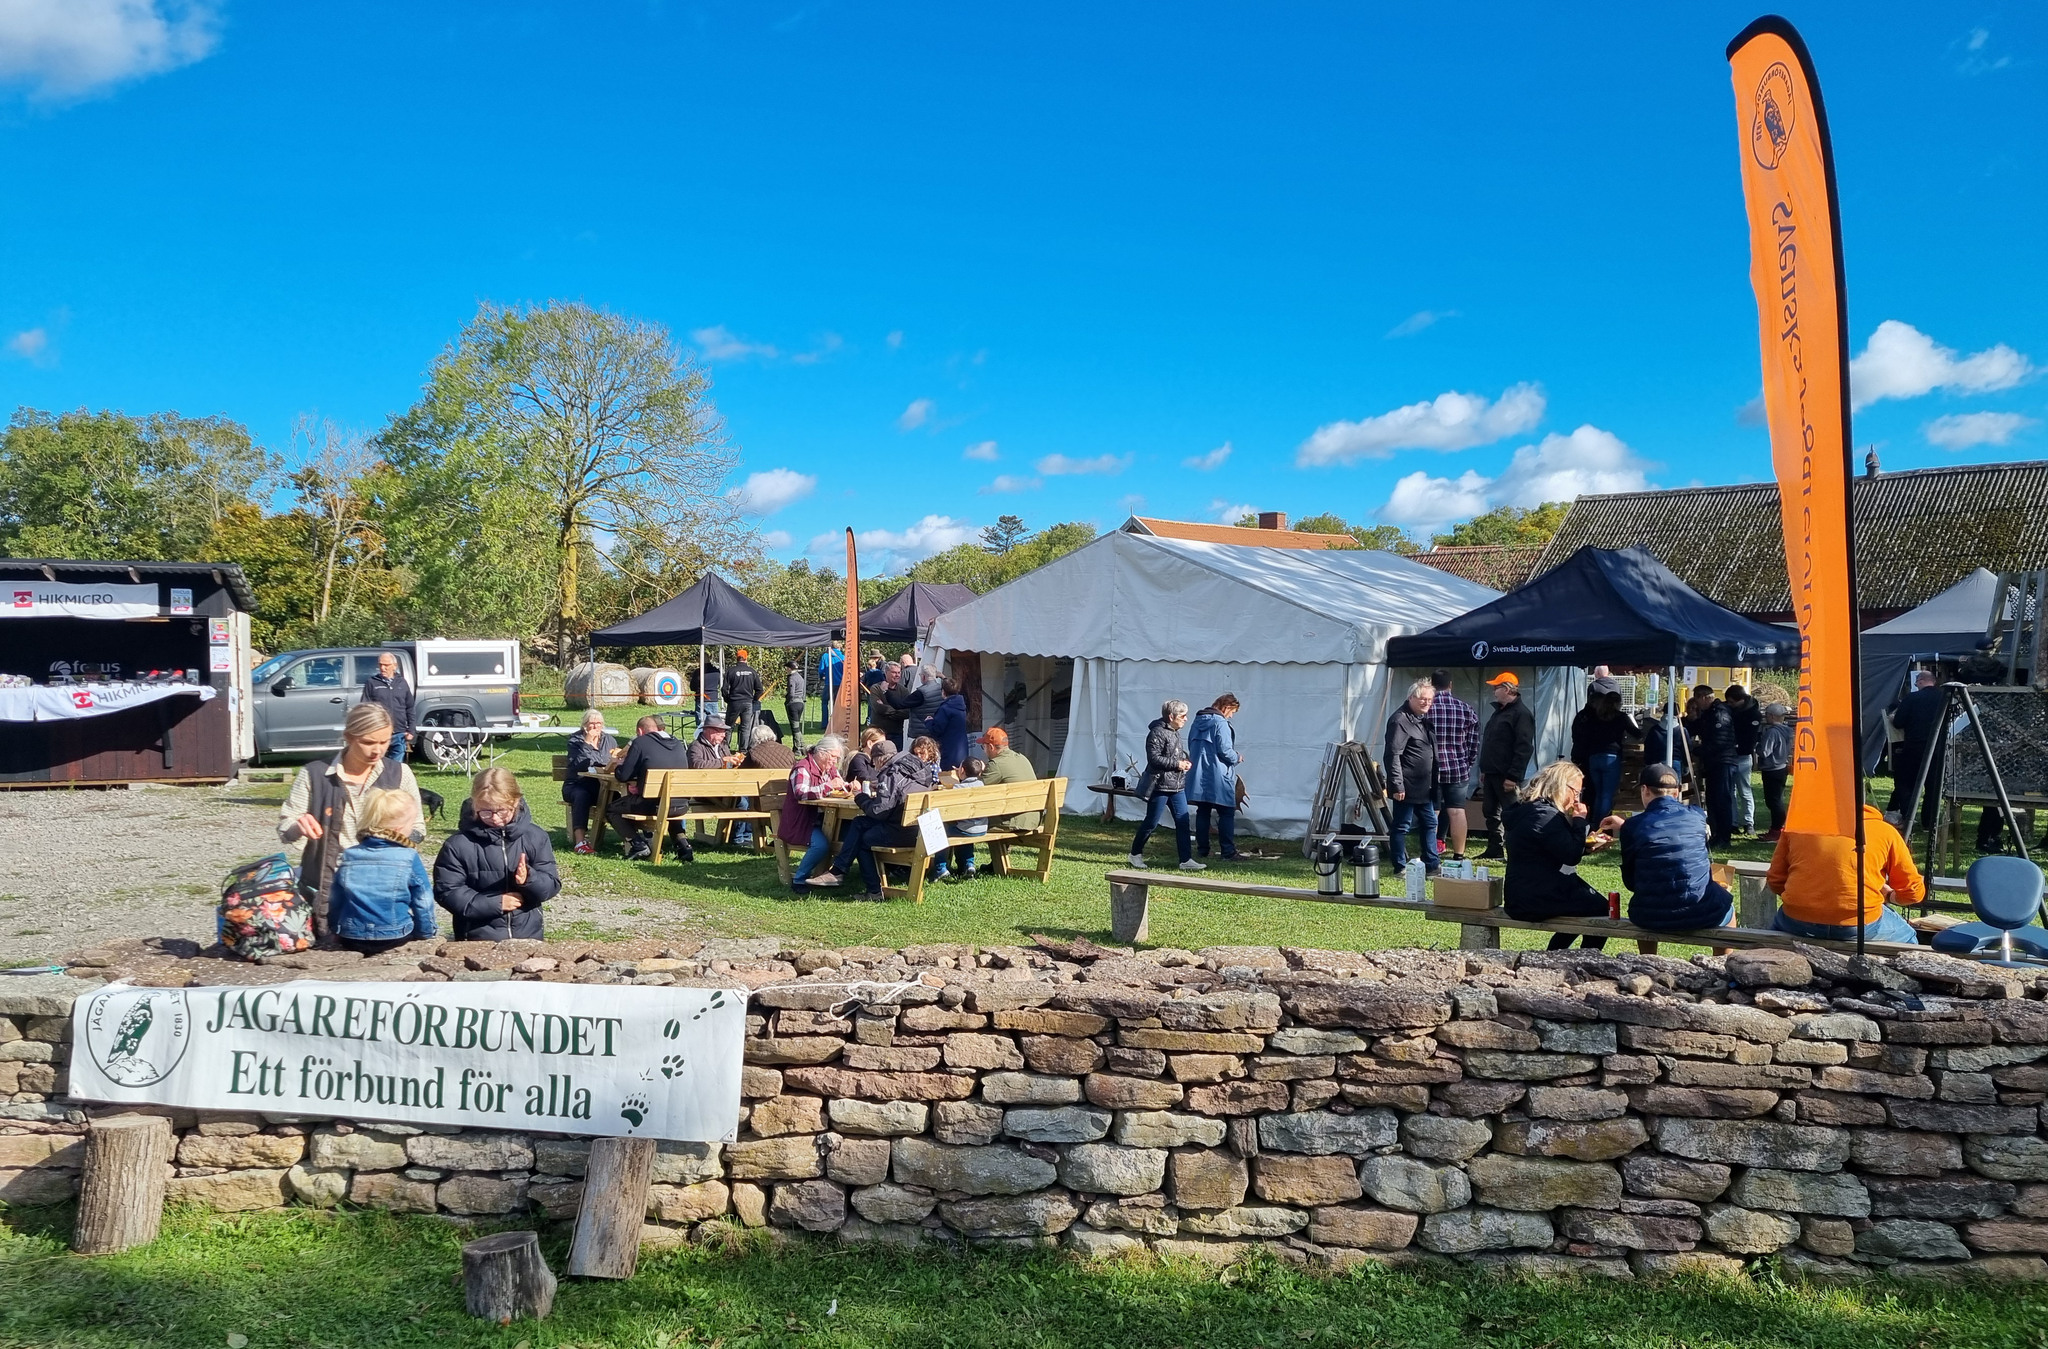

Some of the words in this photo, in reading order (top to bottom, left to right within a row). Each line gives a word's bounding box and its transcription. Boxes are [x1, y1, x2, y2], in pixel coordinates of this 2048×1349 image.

[39, 594, 113, 604] HIKMICRO
[1493, 645, 1519, 653] Svenska
[1520, 644, 1575, 654] Jägareförbundet
[97, 682, 169, 703] HIKMIC
[173, 1013, 183, 1037] 1830
[227, 1049, 287, 1097] Ett
[298, 1055, 445, 1110] förbund
[458, 1068, 514, 1113] för
[524, 1073, 592, 1120] alla
